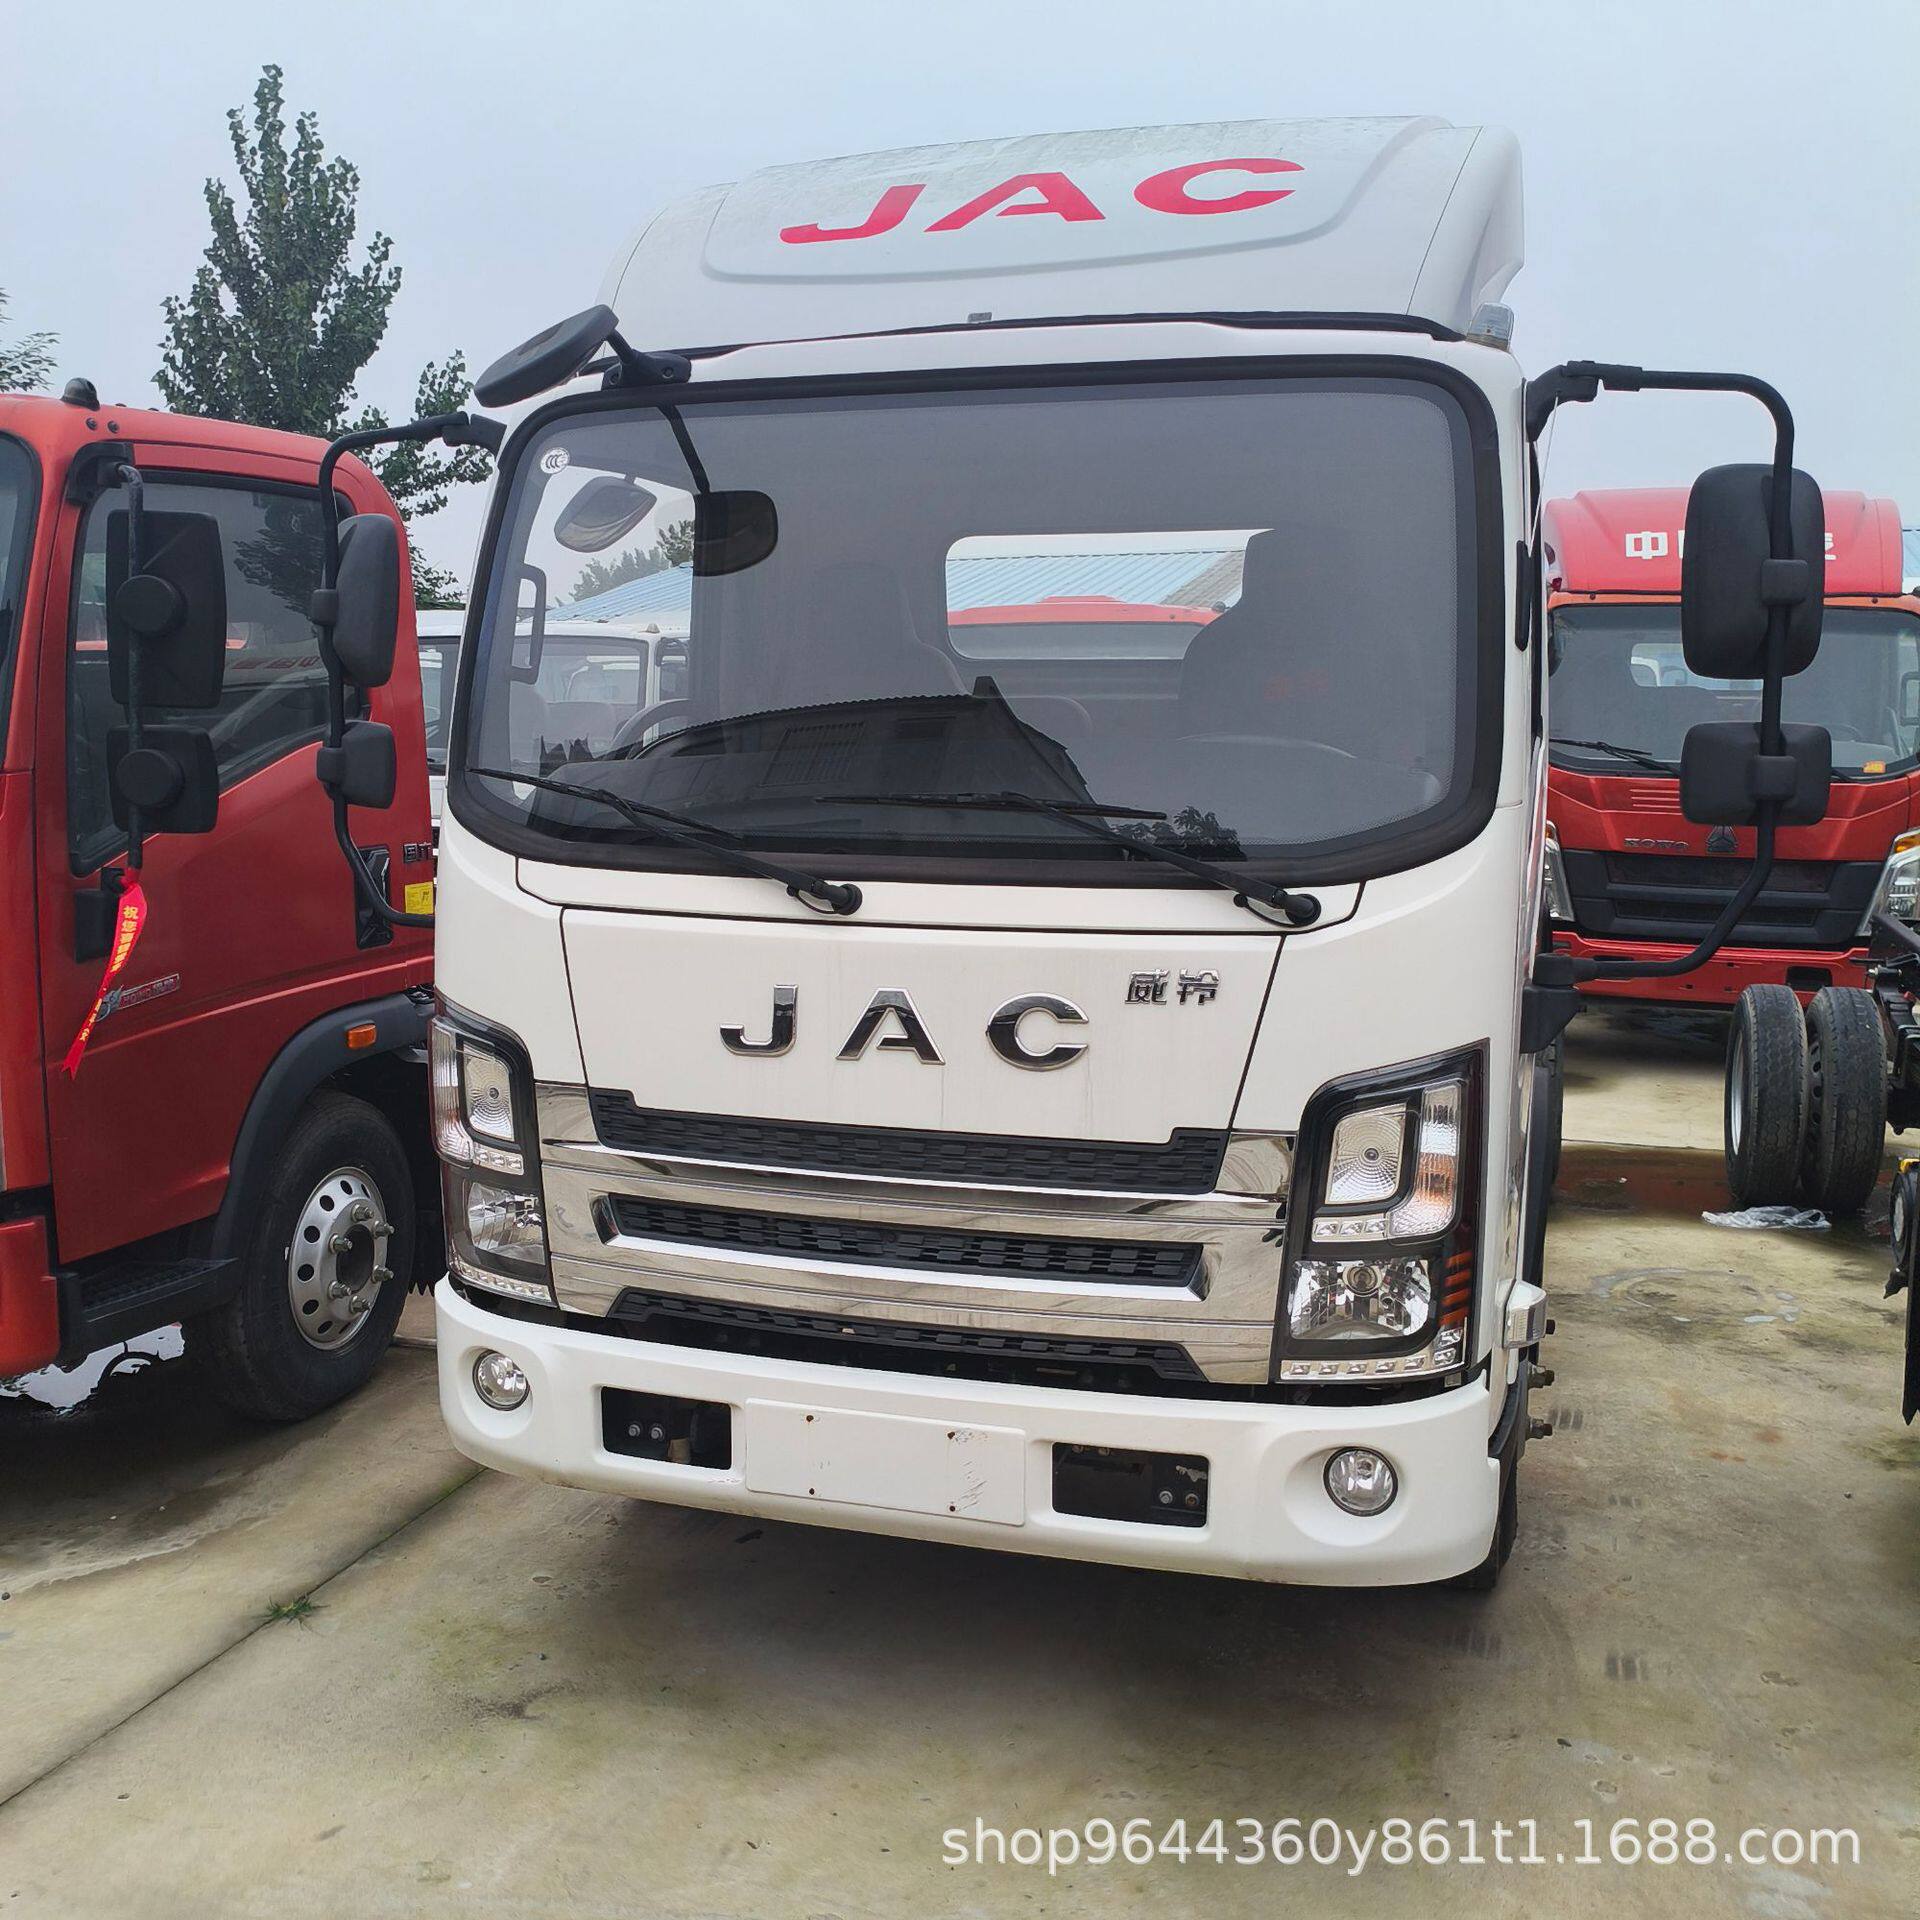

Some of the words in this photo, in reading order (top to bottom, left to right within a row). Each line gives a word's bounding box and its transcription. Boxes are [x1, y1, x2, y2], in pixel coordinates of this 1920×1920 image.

[779, 157, 1305, 244] JAC
[719, 983, 1090, 1072] JAC
[1124, 969, 1219, 1005] 威铃
